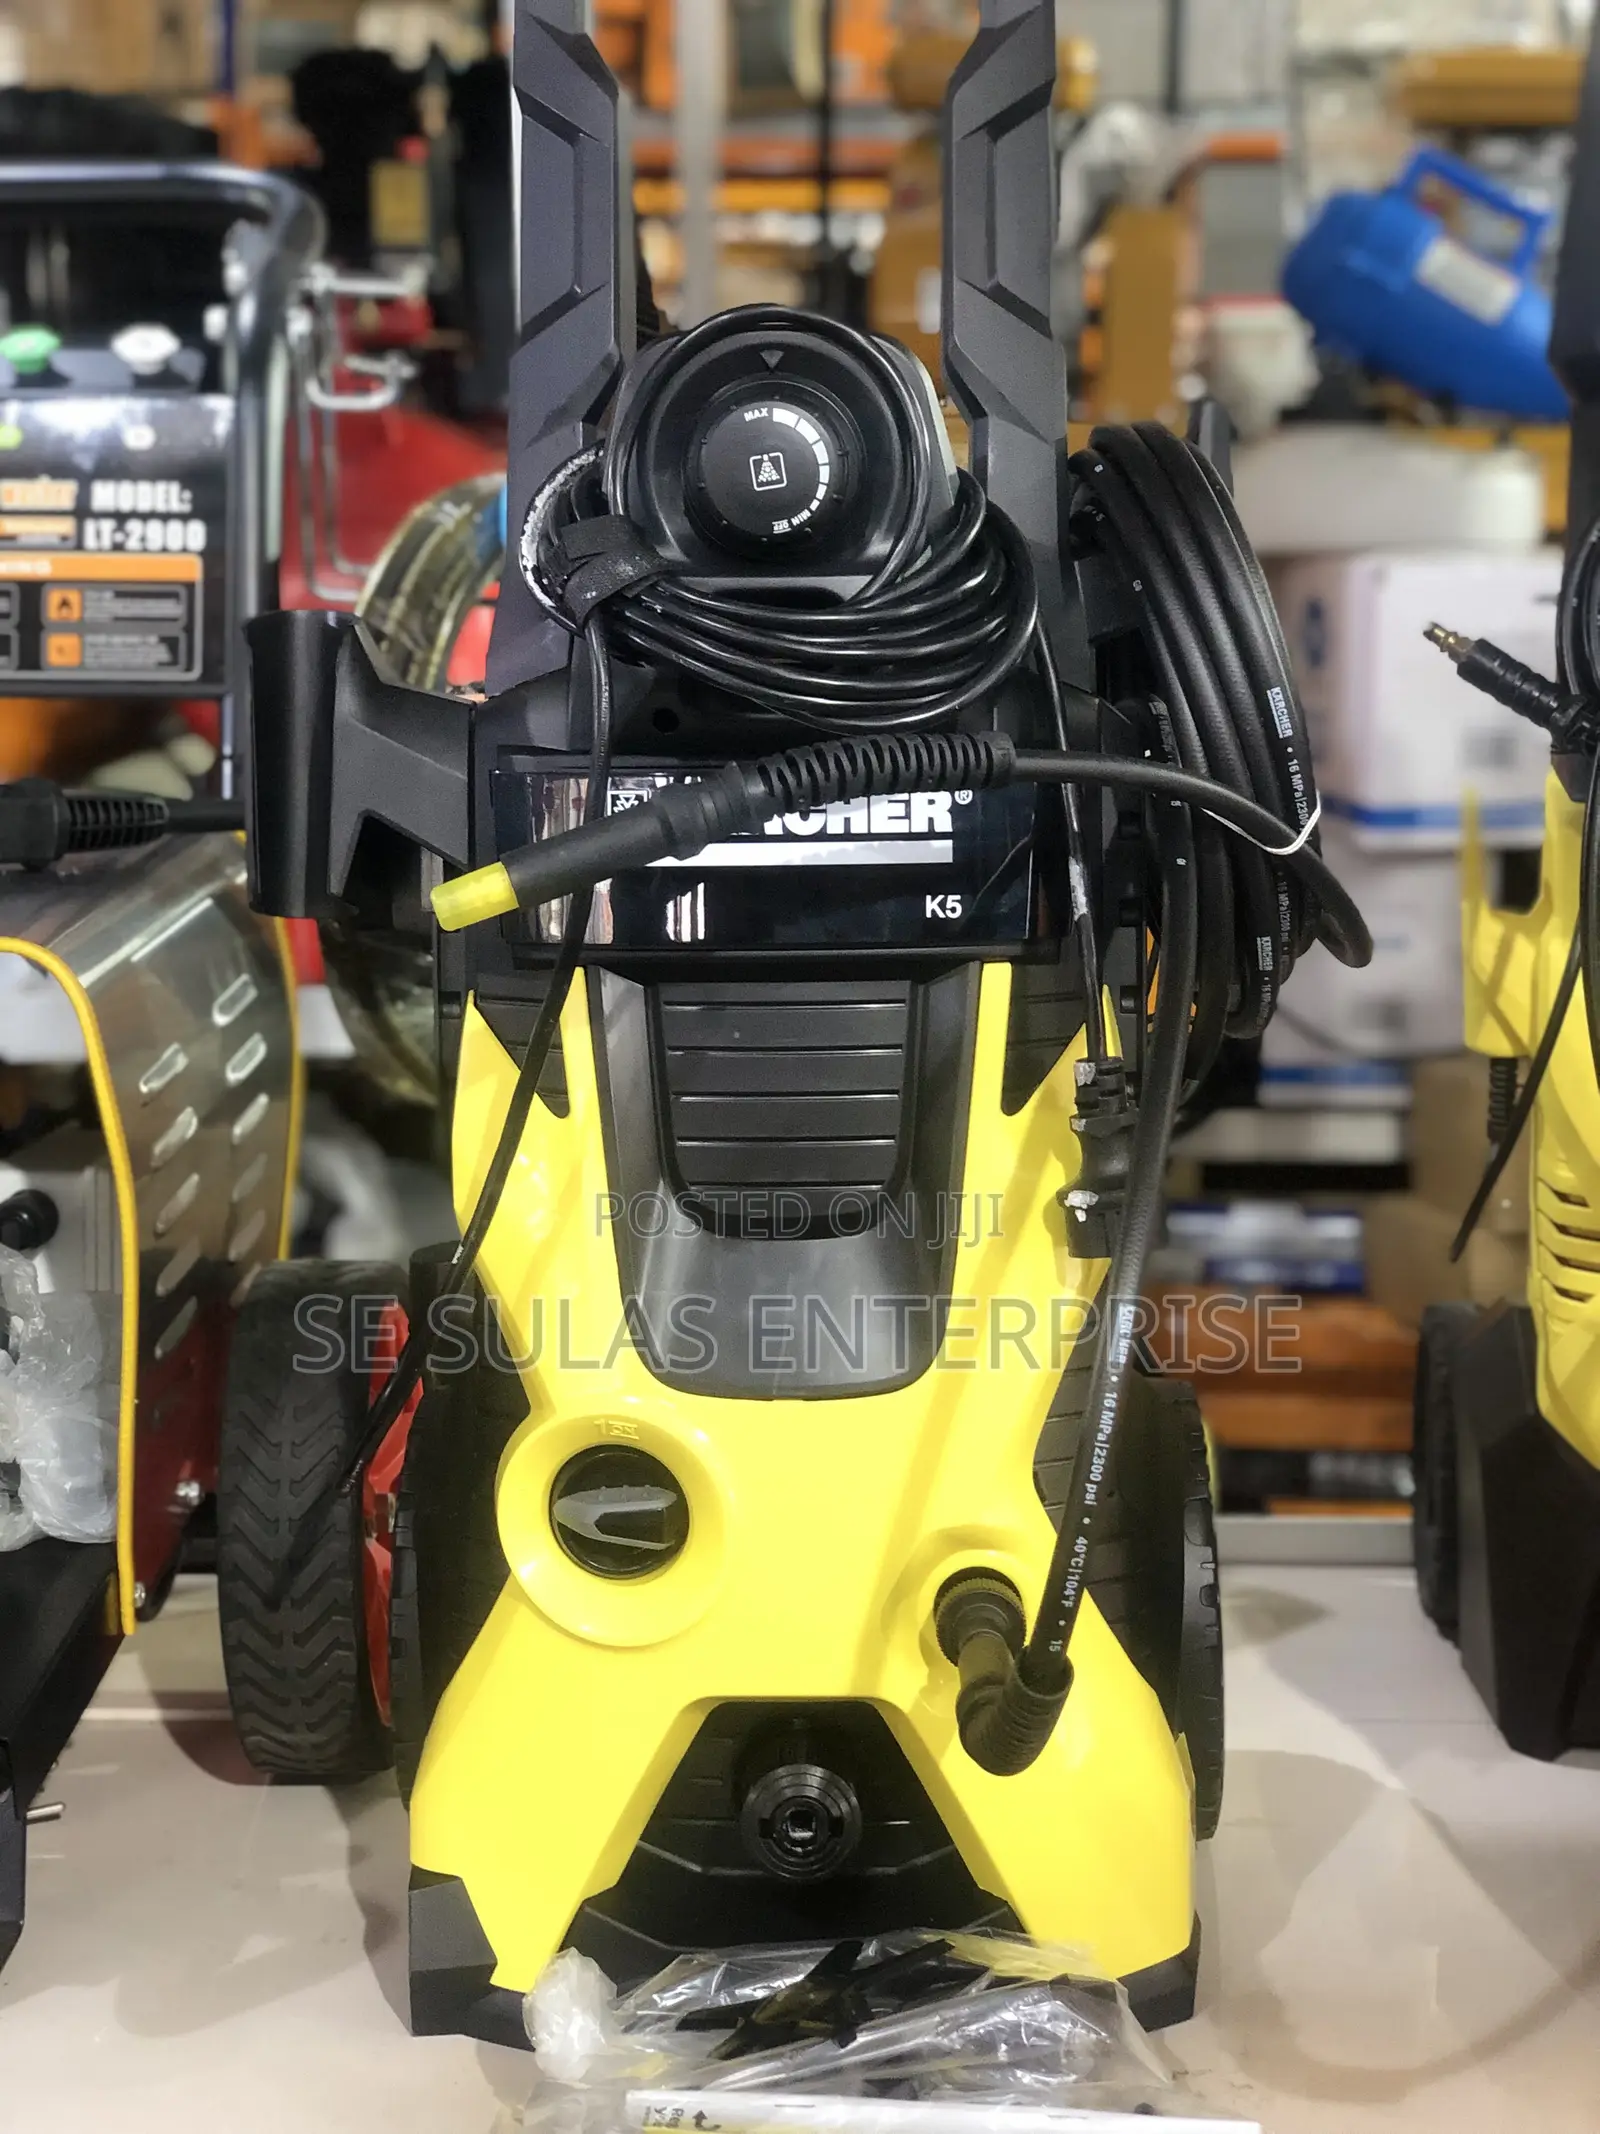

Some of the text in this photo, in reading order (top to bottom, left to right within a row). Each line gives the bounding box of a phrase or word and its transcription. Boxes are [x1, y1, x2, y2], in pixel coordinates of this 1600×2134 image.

[744, 407, 769, 422] MAX
[90, 480, 193, 513] MODEL:
[791, 509, 812, 527] MIN
[772, 520, 790, 533] OFF
[1287, 759, 1300, 773] 16
[925, 895, 962, 919] K5
[1103, 1392, 1118, 1408] 16
[1083, 1483, 1098, 1505] psi
[1049, 1638, 1063, 1652] 15
